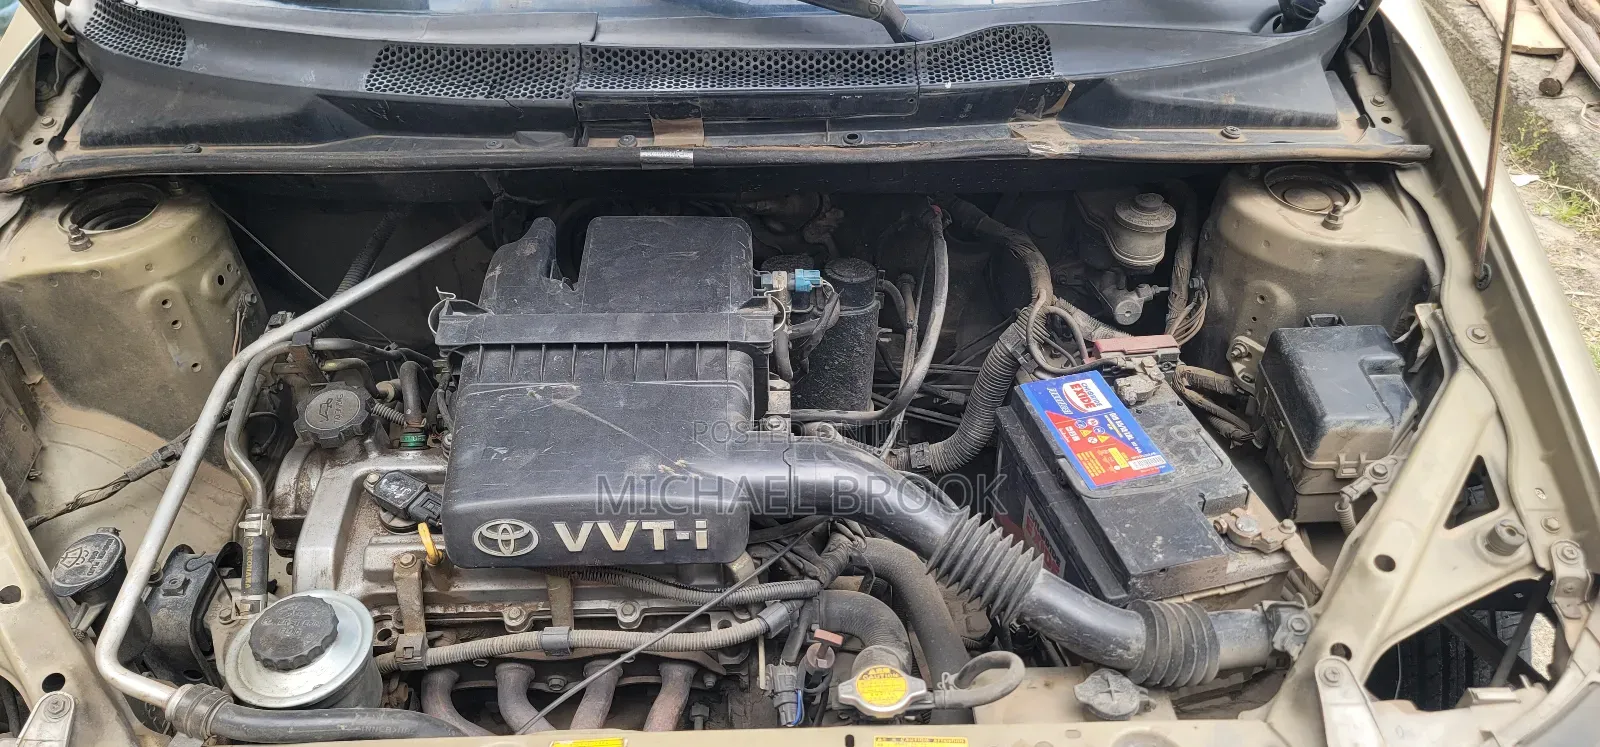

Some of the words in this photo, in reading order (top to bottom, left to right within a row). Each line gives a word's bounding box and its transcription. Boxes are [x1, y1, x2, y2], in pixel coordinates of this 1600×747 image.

[1069, 383, 1097, 409] EXIDE
[1081, 382, 1103, 407] CHLORIDE
[553, 520, 709, 552] VVT-i
[245, 545, 254, 589] YOKOHAMA
